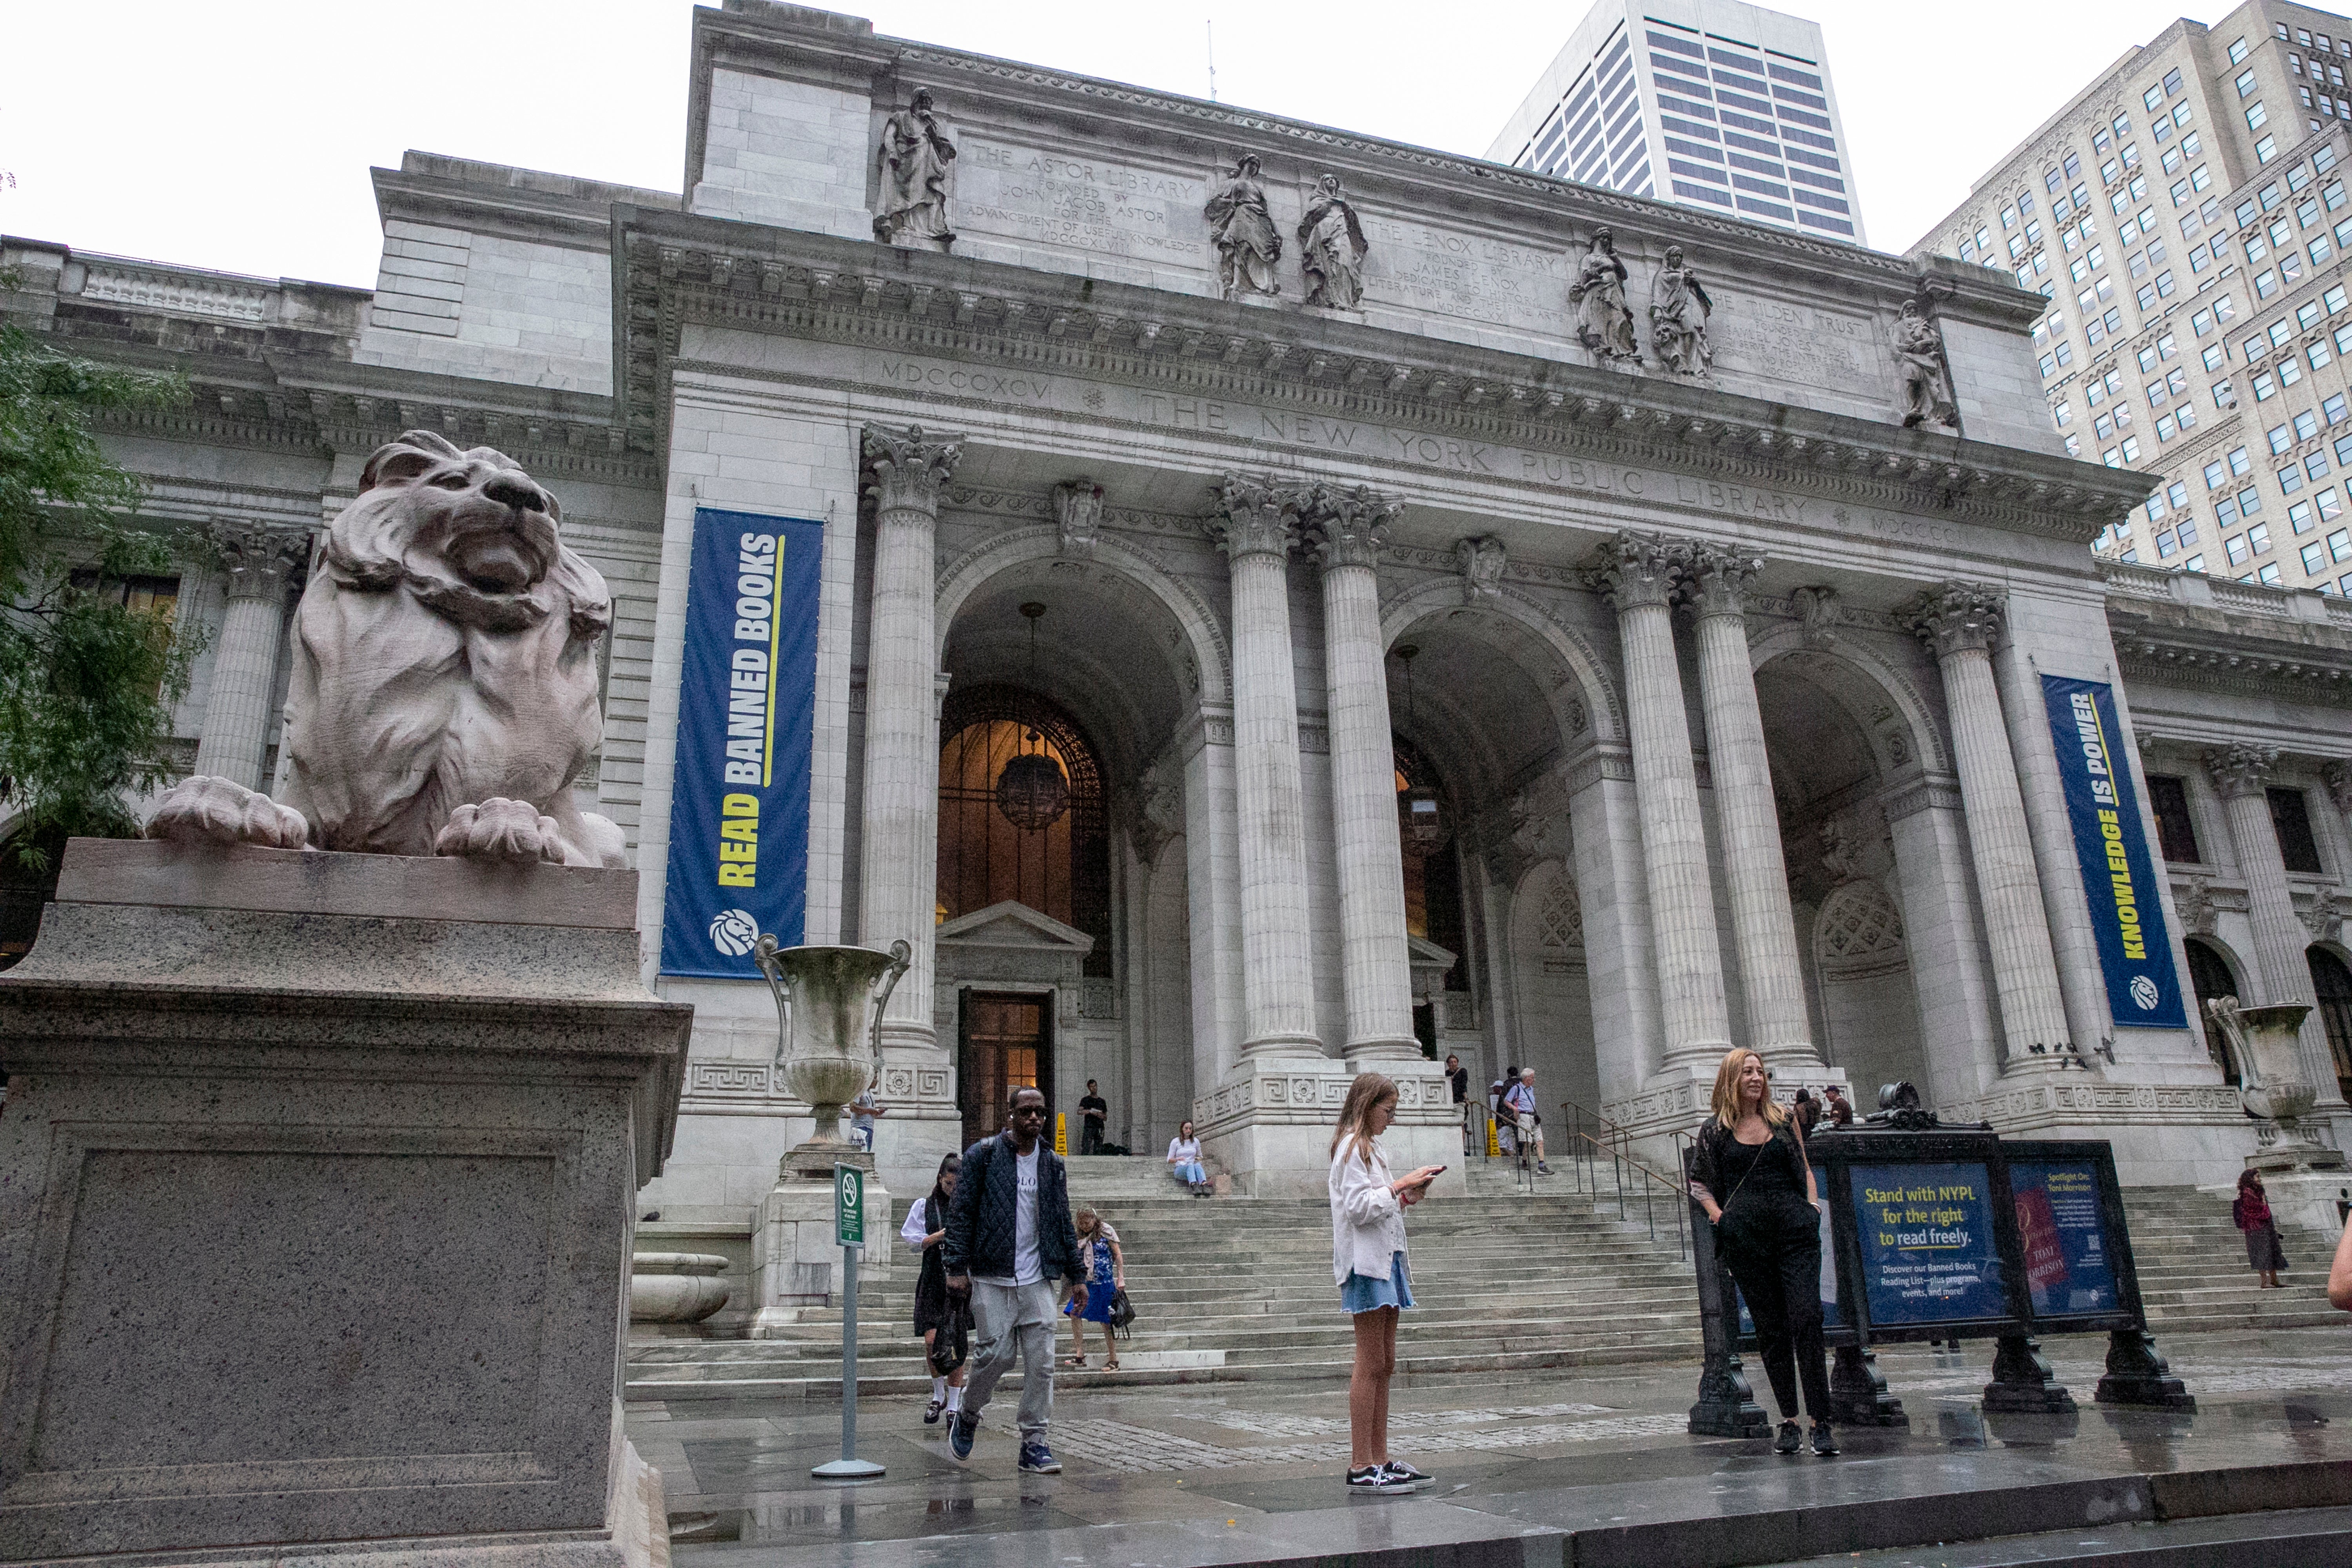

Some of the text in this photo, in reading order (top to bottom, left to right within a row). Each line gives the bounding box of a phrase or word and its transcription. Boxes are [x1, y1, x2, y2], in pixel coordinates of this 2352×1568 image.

[972, 145, 1192, 198] THE ASTOR LIBRARY
[1039, 180, 1128, 203] FOUNDED BY
[1001, 185, 1165, 224] JOHN JACOB ASTOR
[1054, 207, 1112, 225] FOR THE
[967, 206, 1201, 254] ADVANCEMENT OF USEFUL KNOWLEDGE
[1367, 221, 1556, 272] THE LENOX LIBRARY
[1427, 254, 1504, 275] FOUNDED BY
[1395, 271, 1457, 290] DEDICATED
[1464, 285, 1480, 294] TO
[1413, 262, 1519, 292] JAMES LENOX
[1368, 277, 1442, 298] LITERATURE
[1450, 294, 1472, 304] AND
[1479, 298, 1500, 310] THE
[1508, 304, 1532, 316] FINE
[1746, 300, 1803, 325] TILDEN
[1815, 314, 1862, 334] TRUST
[1755, 321, 1800, 337] FOUNDED
[1776, 336, 1811, 351] JONES
[881, 360, 1052, 399] MDCCCXCV
[1140, 394, 1229, 430] THE
[1261, 411, 1357, 447] NEW
[1392, 432, 1490, 470] YORK
[1520, 454, 1644, 495] PUBLIC
[1675, 479, 1806, 520] LIBRARY
[718, 532, 776, 887] READ BANNED BOOKS
[2070, 693, 2147, 960] KNOWLEDGE IS POWER
[2048, 1173, 2076, 1182] Spotlight
[2063, 1183, 2091, 1192] Morrison
[1866, 1186, 1976, 1203] Stand with NYPL
[1883, 1207, 1964, 1226] for the right
[1879, 1228, 1972, 1247] to read freely.
[2033, 1245, 2054, 1261] TONI
[1883, 1265, 1912, 1274] Discover
[1928, 1263, 1954, 1272] Banned
[1955, 1262, 1976, 1270] Books
[2027, 1259, 2064, 1279] ORRISON
[1881, 1278, 1909, 1287] Reading
[1946, 1276, 1981, 1285] programs,
[1902, 1287, 1963, 1298] events, and more!
